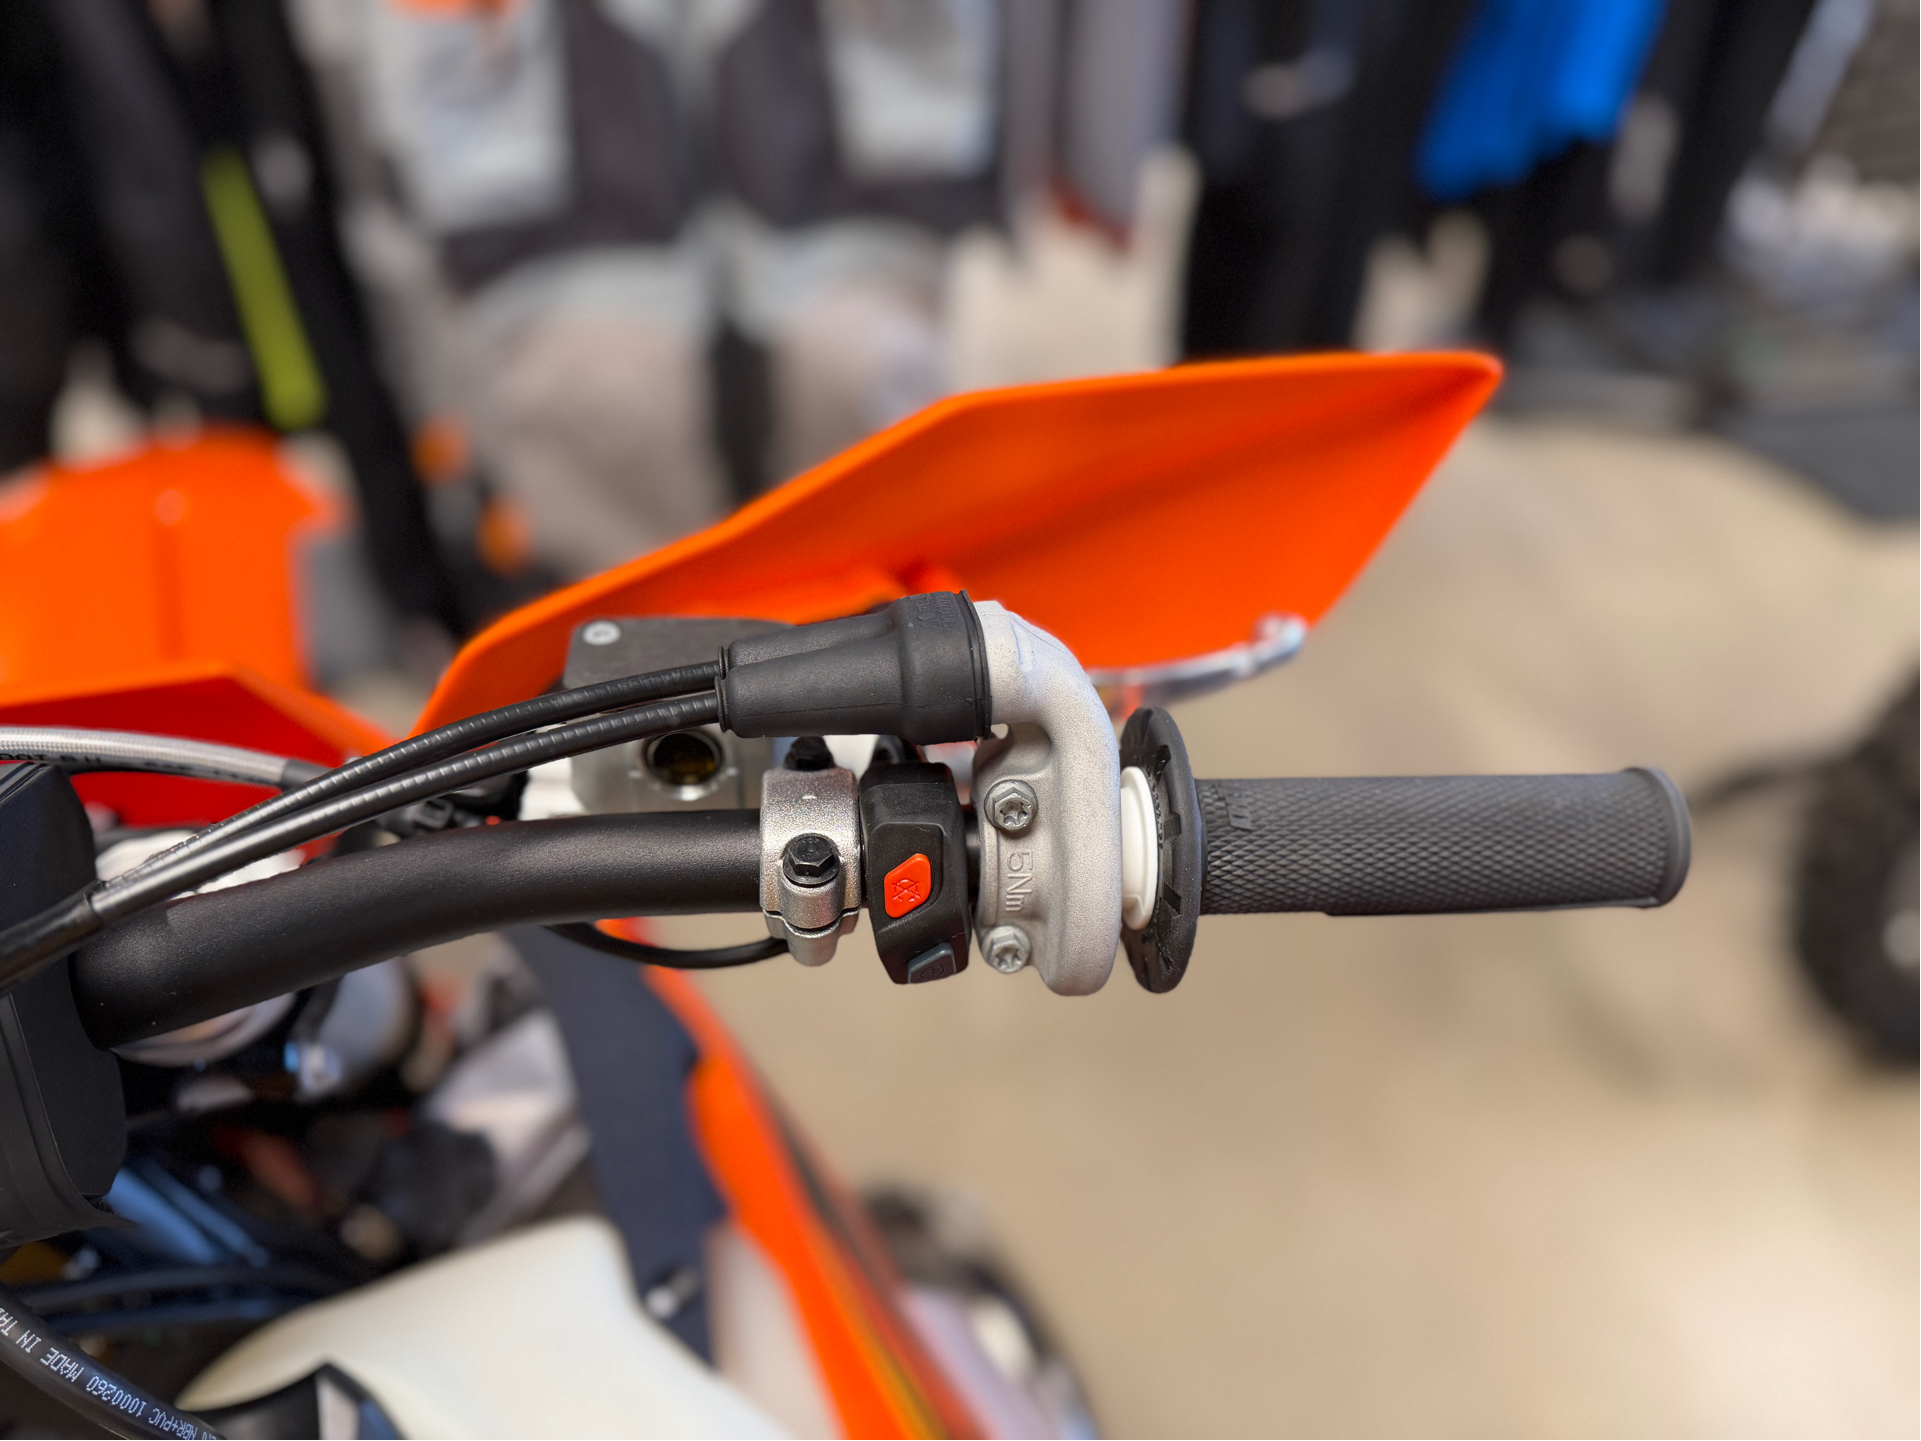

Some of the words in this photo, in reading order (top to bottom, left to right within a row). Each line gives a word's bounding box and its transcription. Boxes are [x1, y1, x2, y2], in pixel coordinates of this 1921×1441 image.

[1005, 850, 1033, 911] 5Nm
[15, 1329, 42, 1354] IN
[39, 1346, 85, 1383] MADE
[85, 1375, 148, 1418] 1000260
